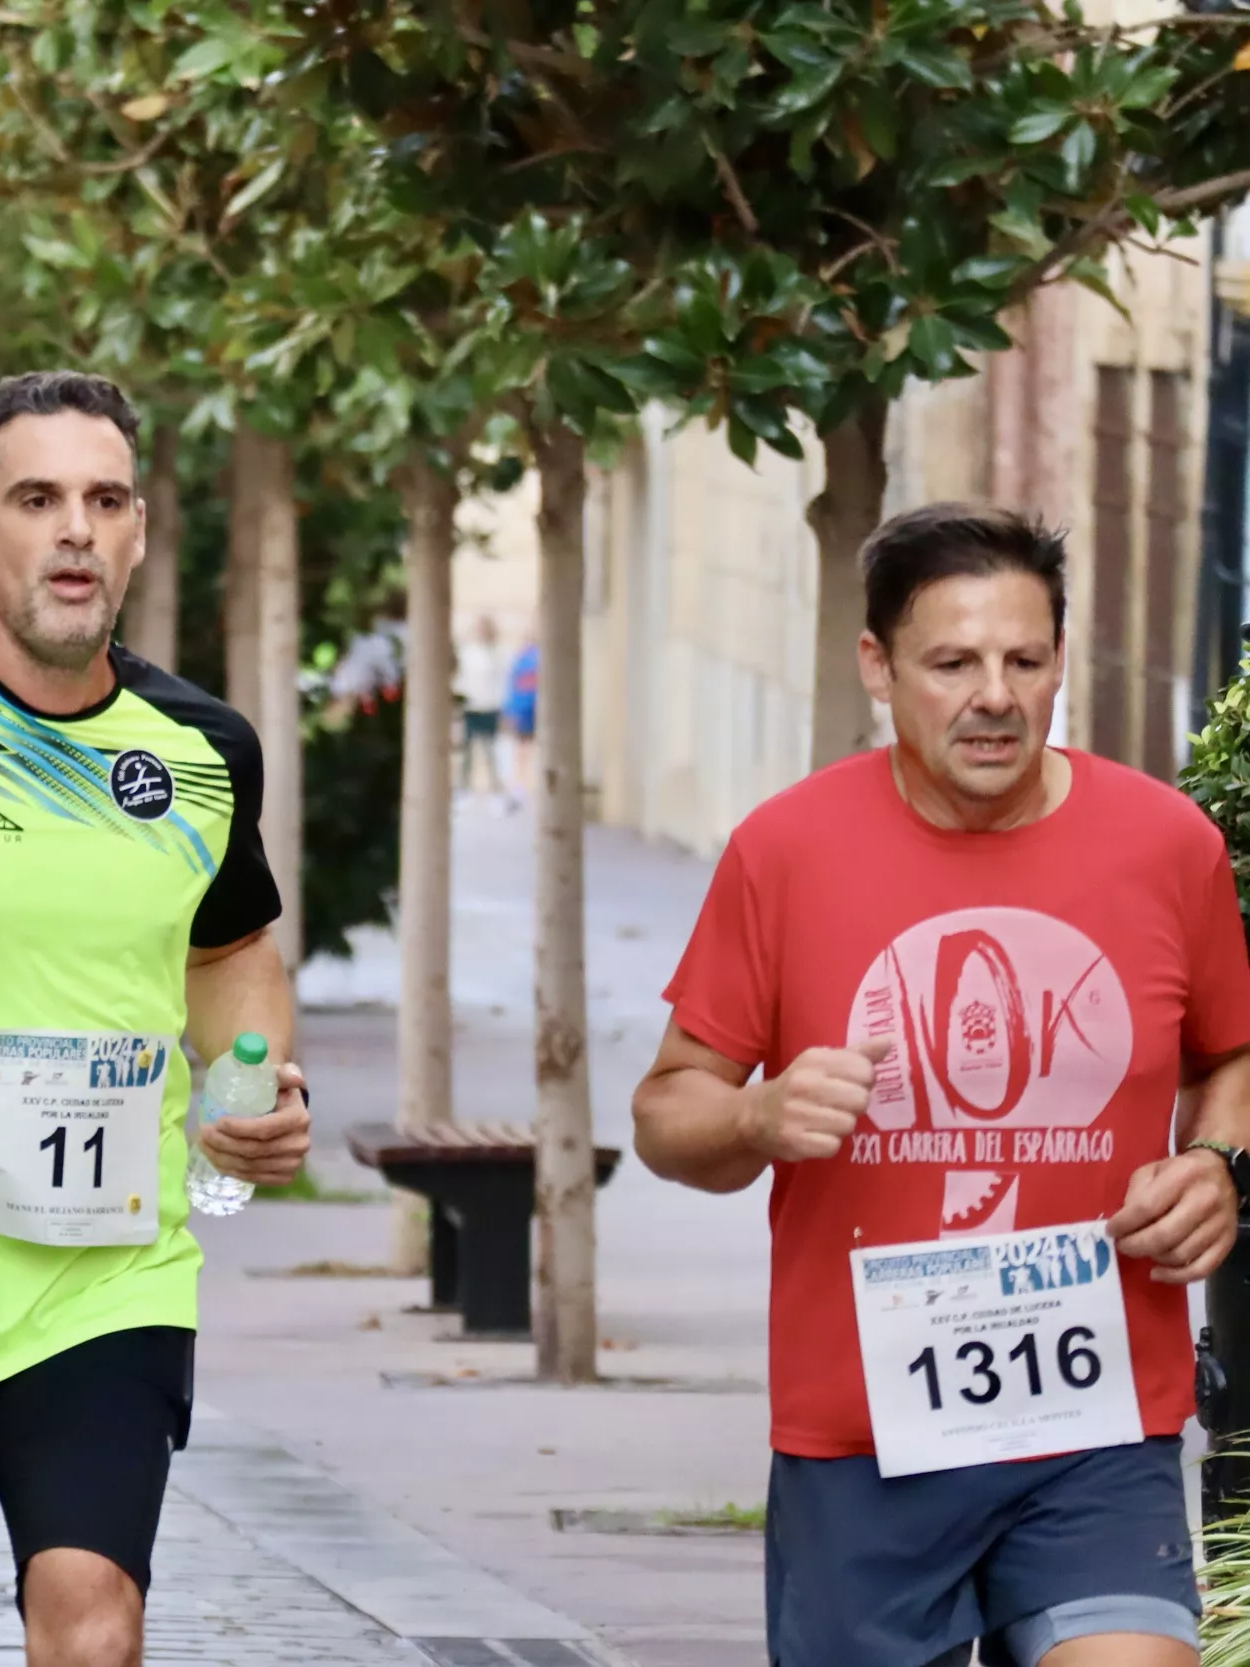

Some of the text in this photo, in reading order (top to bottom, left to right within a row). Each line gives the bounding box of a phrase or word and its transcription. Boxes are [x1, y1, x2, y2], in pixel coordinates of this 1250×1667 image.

[89, 1037, 133, 1061] 2024
[38, 1126, 105, 1189] 11
[851, 1125, 1114, 1164] XXI CARRERA DEL ESPÁRRAGO
[992, 1235, 1060, 1269] 2024
[907, 1325, 1103, 1411] 1316
